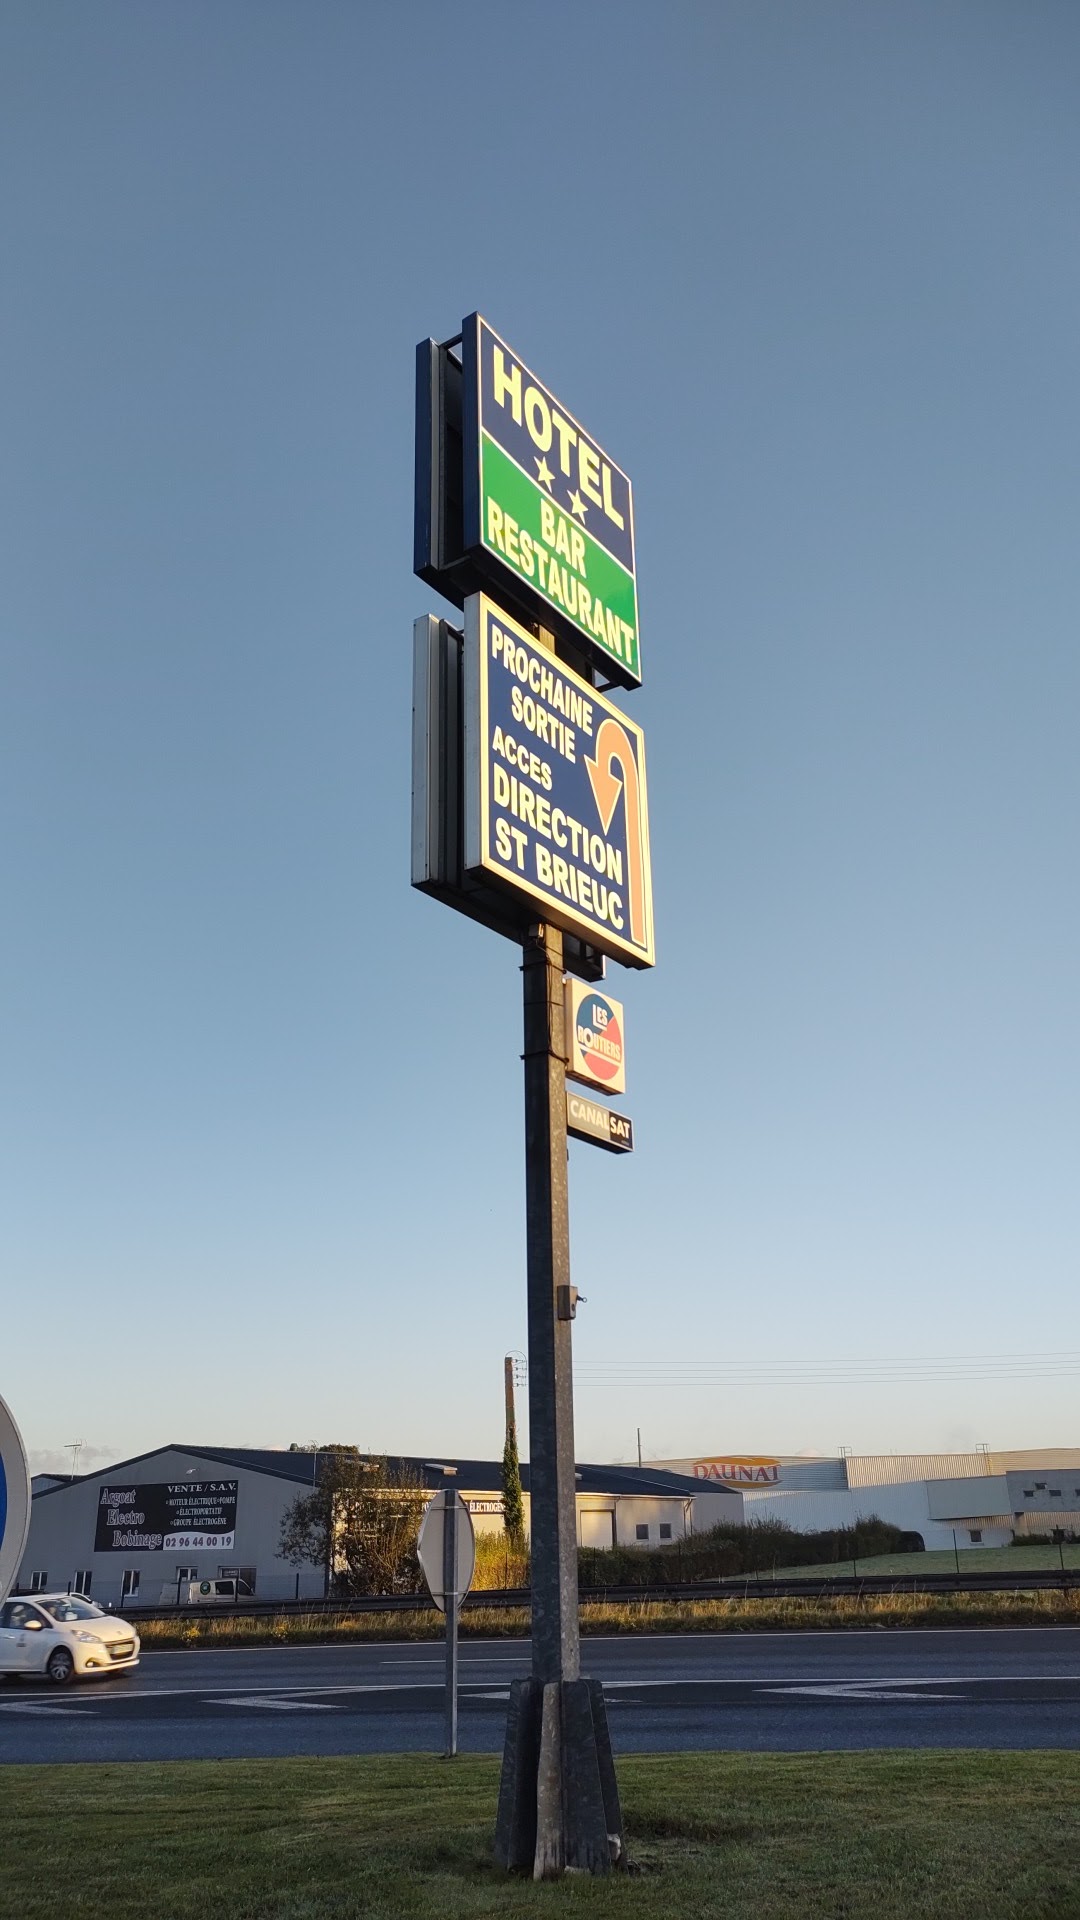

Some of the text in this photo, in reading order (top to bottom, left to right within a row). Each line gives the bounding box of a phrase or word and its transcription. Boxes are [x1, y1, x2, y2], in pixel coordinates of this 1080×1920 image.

[494, 344, 625, 531] HOTEL
[541, 498, 587, 578] BAR
[487, 496, 635, 665] RESTAURANT
[492, 624, 593, 736] PROCHAINE
[511, 686, 576, 764] SORTIE
[492, 725, 553, 791] ACCES
[494, 762, 623, 886] DIRECTION
[495, 817, 624, 930] ST BRIEUC
[577, 1025, 621, 1061] ROUTIERS
[593, 1004, 608, 1031] LES
[100, 1488, 136, 1507] Argoat
[168, 1484, 202, 1493] VENTE
[210, 1482, 237, 1492] S.A.V.
[693, 1464, 781, 1481] DAUNAT
[107, 1509, 145, 1525] Electro
[112, 1530, 162, 1549] Bobinage
[165, 1536, 232, 1548] 02 96 44 00 19
